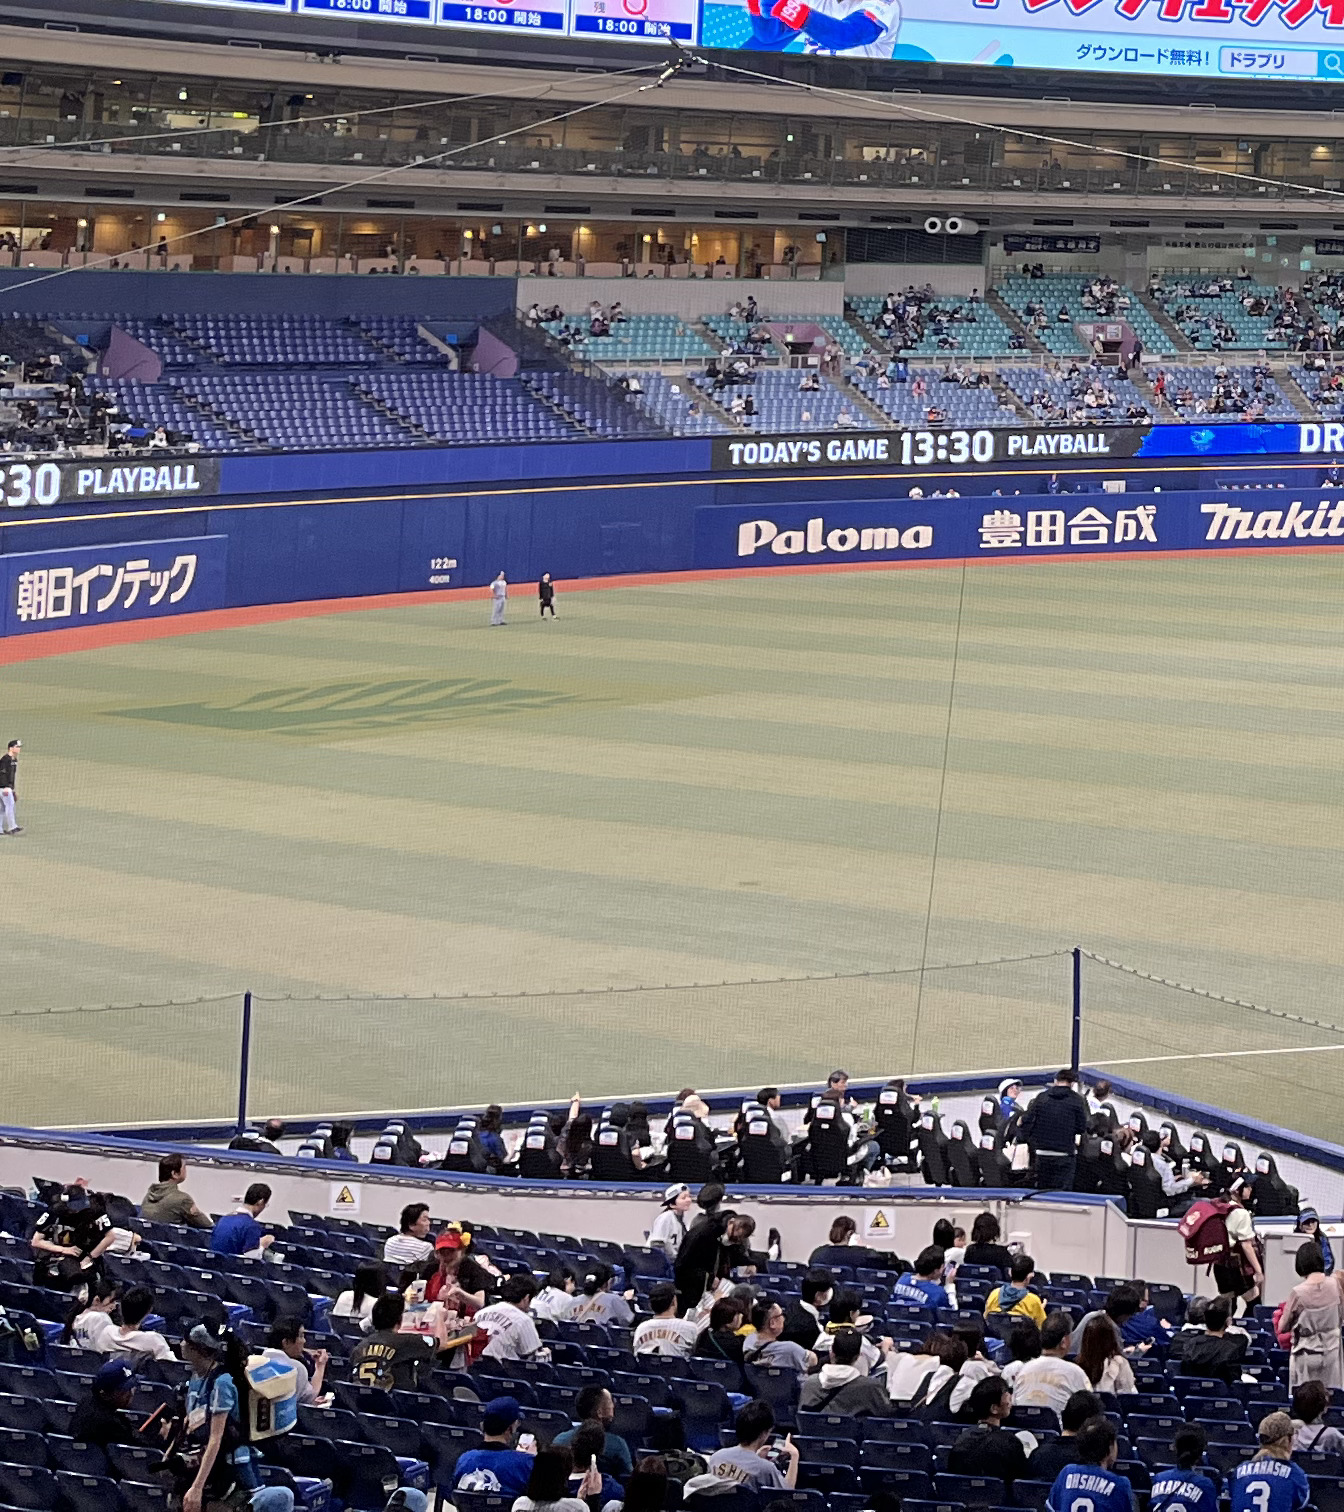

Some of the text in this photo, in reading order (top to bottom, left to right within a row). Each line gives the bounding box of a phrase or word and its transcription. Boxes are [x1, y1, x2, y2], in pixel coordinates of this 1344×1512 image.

[378, 0, 407, 15] 開始
[465, 7, 542, 26] 18:00 開始
[597, 19, 637, 34] 18:00
[1076, 43, 1210, 66] ダウンロード無料！
[729, 431, 1110, 466] TODAY'S GAME 13:30 PLAYBALL
[78, 464, 200, 496] PLAYBALL
[737, 519, 933, 557] Paloma
[978, 505, 1157, 549] 豊田合成
[17, 553, 197, 621] 朝日インテック
